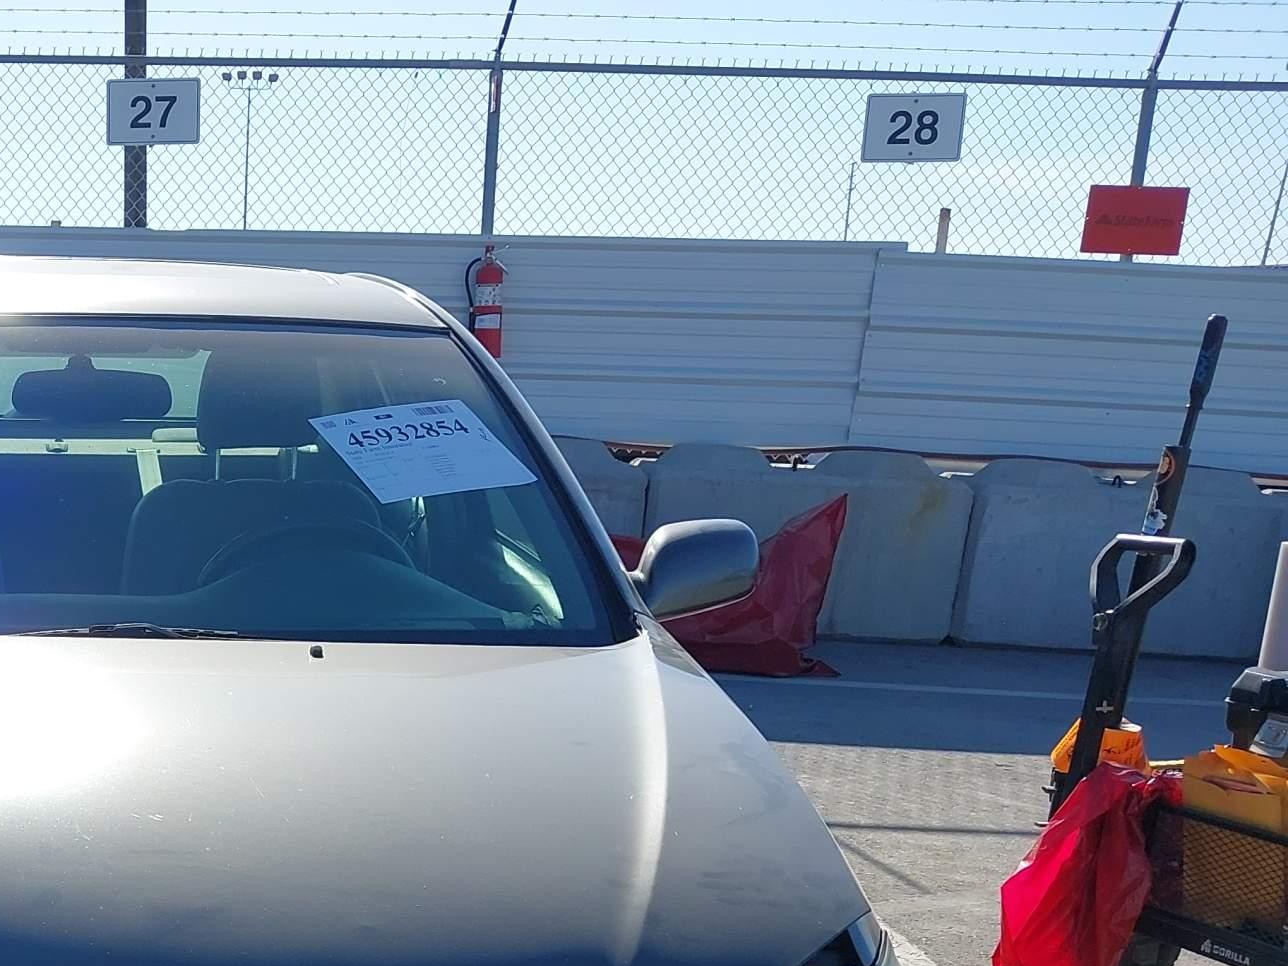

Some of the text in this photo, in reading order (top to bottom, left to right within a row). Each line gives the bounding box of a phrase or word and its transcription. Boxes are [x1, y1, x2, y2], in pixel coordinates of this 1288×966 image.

[129, 95, 178, 129] 27
[886, 110, 939, 146] 28
[348, 418, 470, 448] 45932854
[1213, 945, 1250, 966] GORILLA
